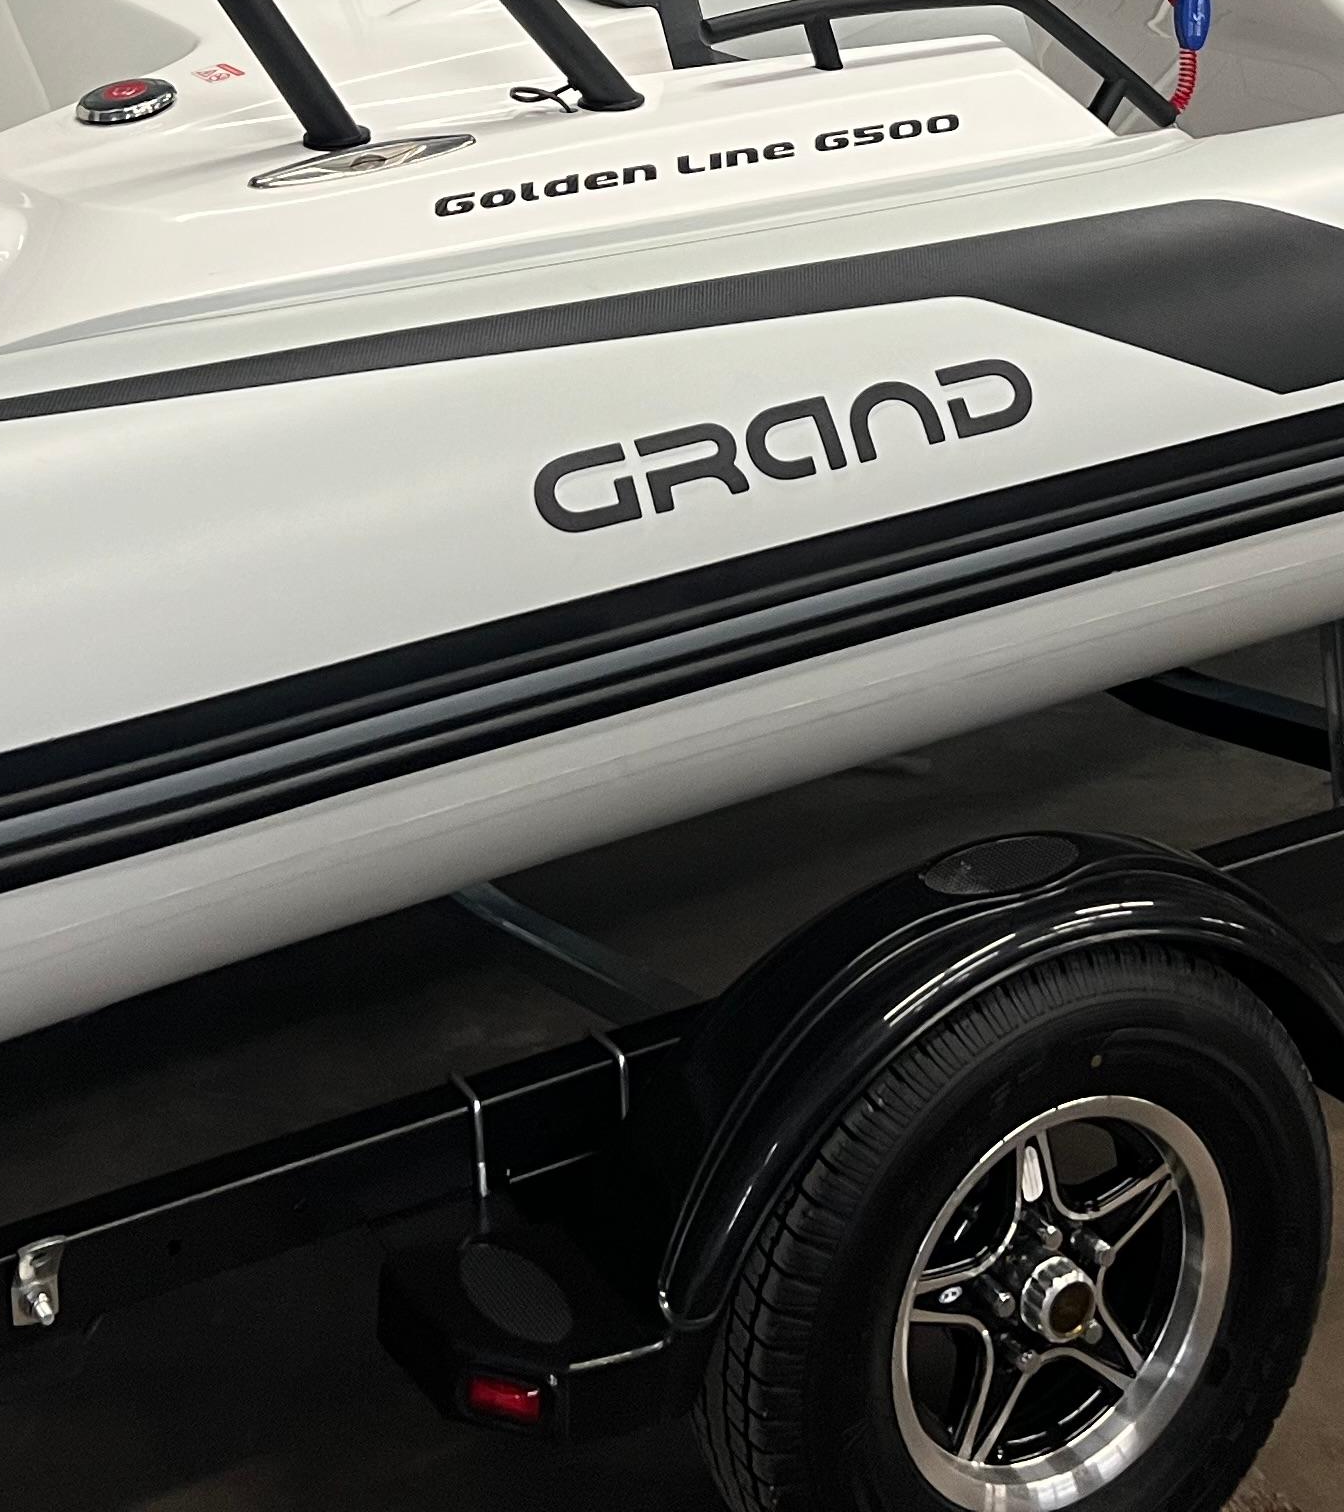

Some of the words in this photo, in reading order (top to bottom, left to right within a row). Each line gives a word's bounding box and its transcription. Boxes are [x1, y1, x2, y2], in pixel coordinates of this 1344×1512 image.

[433, 163, 657, 218] Golden
[676, 140, 796, 176] Line
[814, 113, 960, 153] G500
[533, 358, 1033, 533] GRAND
